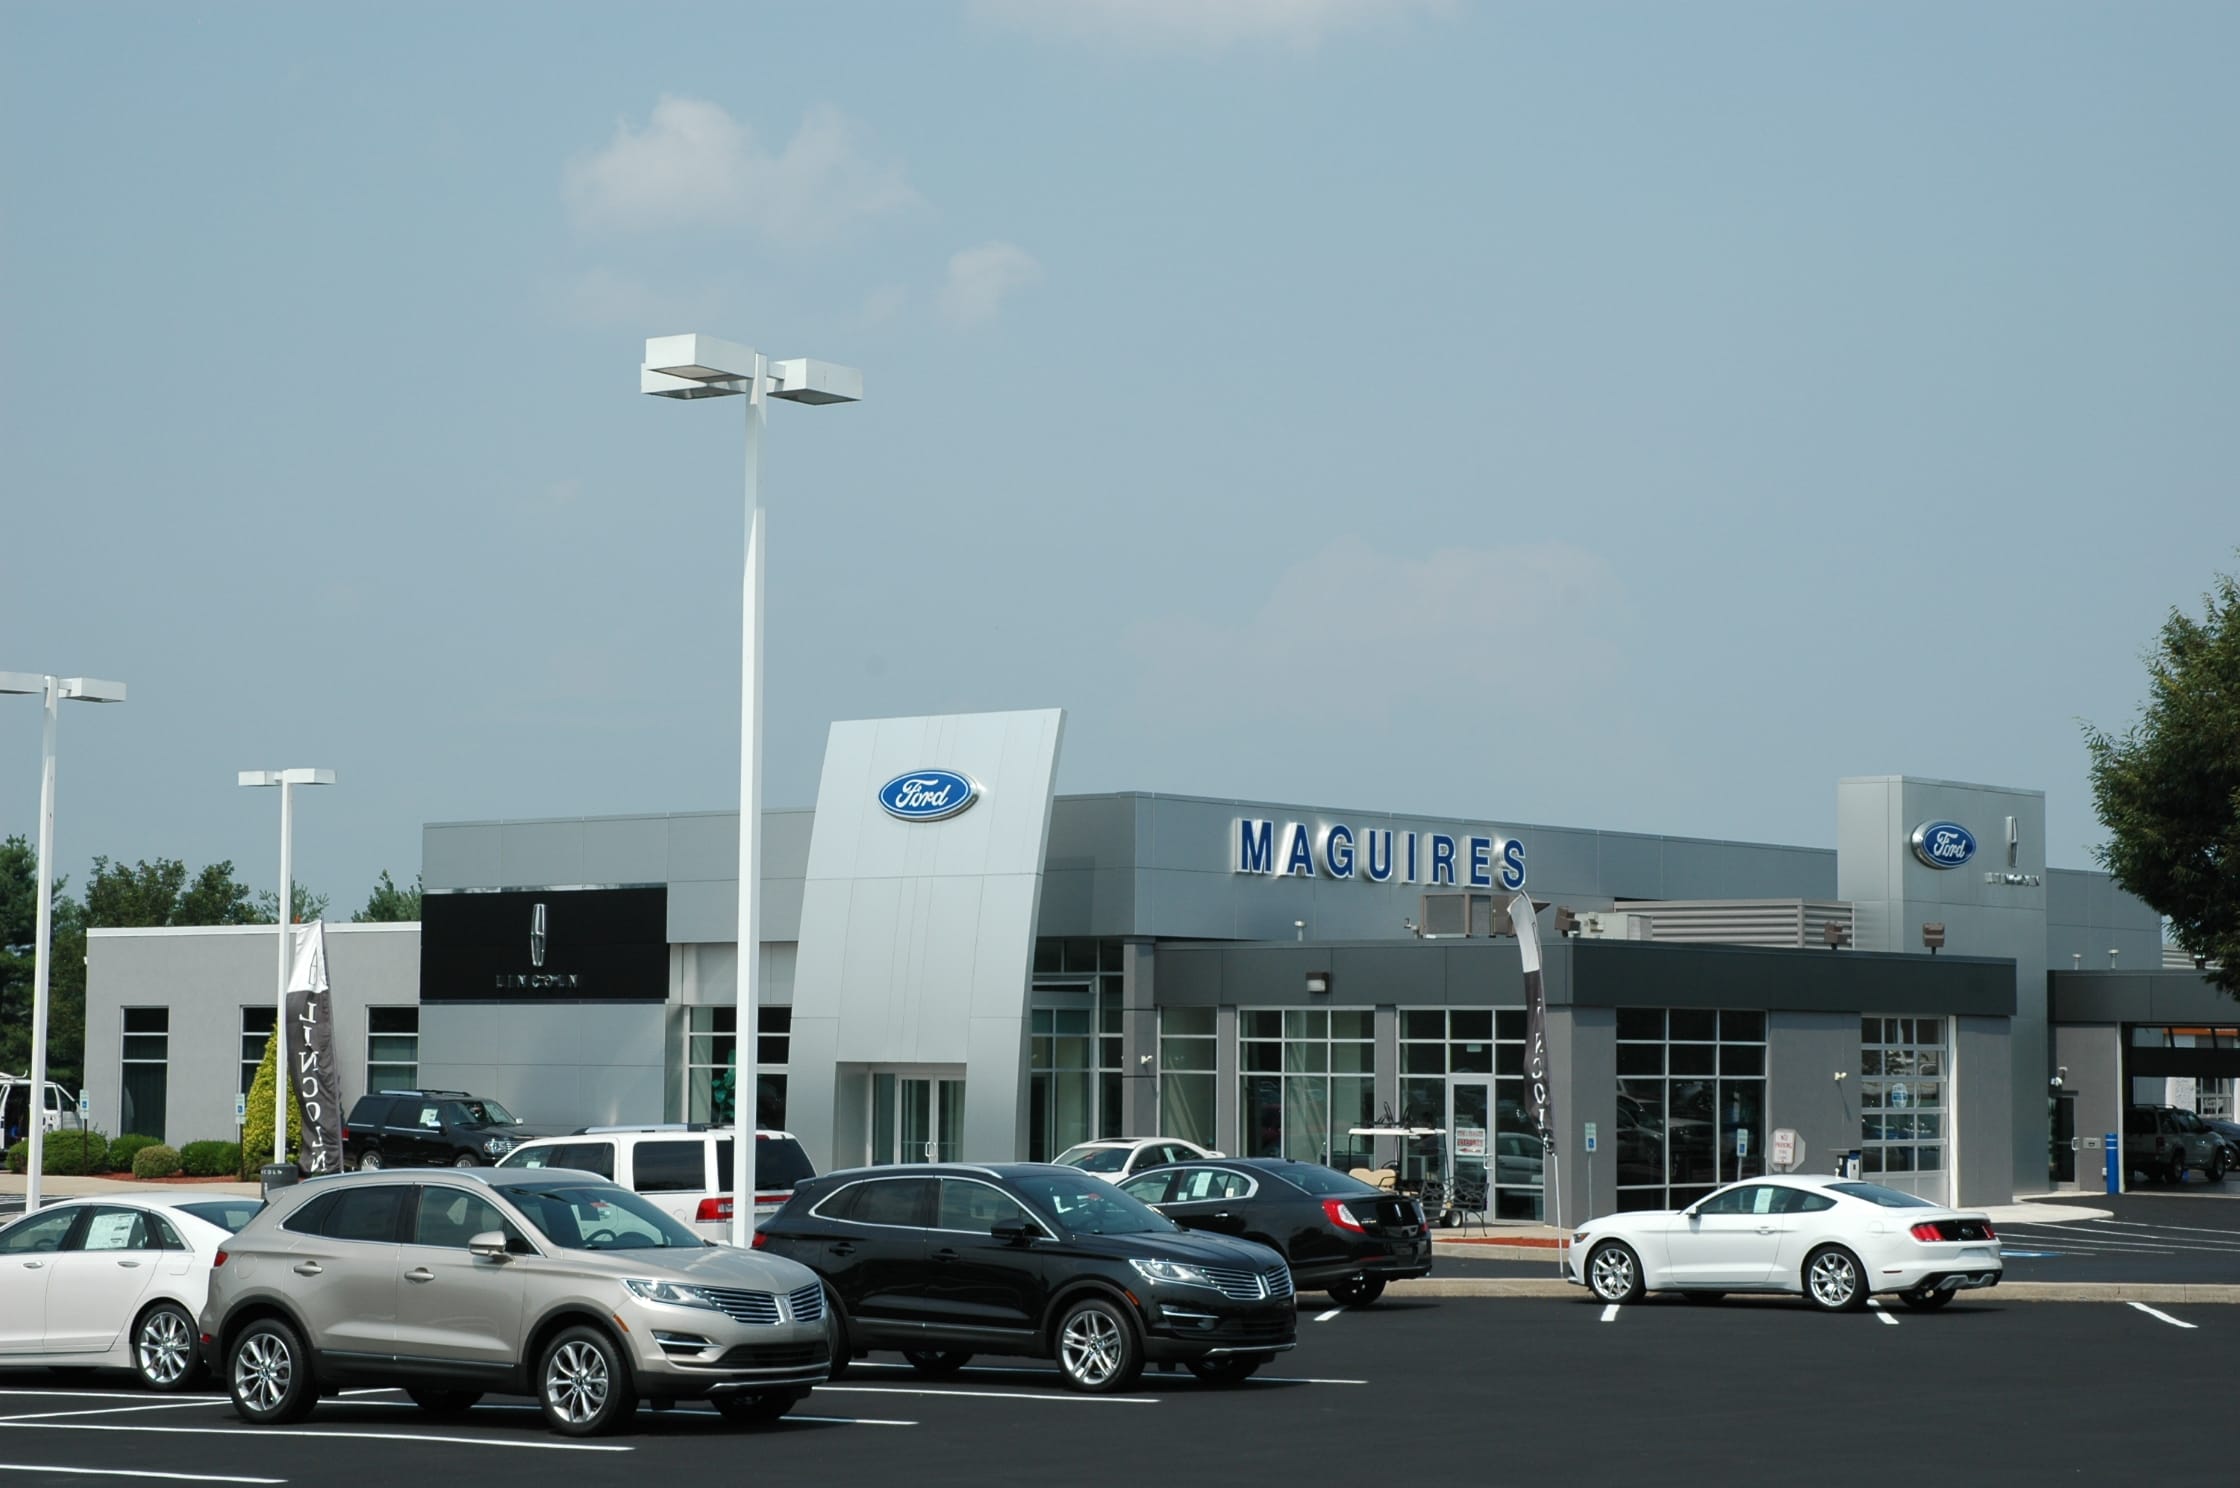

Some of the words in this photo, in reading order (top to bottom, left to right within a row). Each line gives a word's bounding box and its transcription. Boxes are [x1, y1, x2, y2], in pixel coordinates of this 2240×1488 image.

[895, 778, 952, 808] Ford
[1236, 817, 1526, 891] MAGUIRES
[1933, 830, 1967, 858] Ford
[495, 974, 578, 988] LINCOLN
